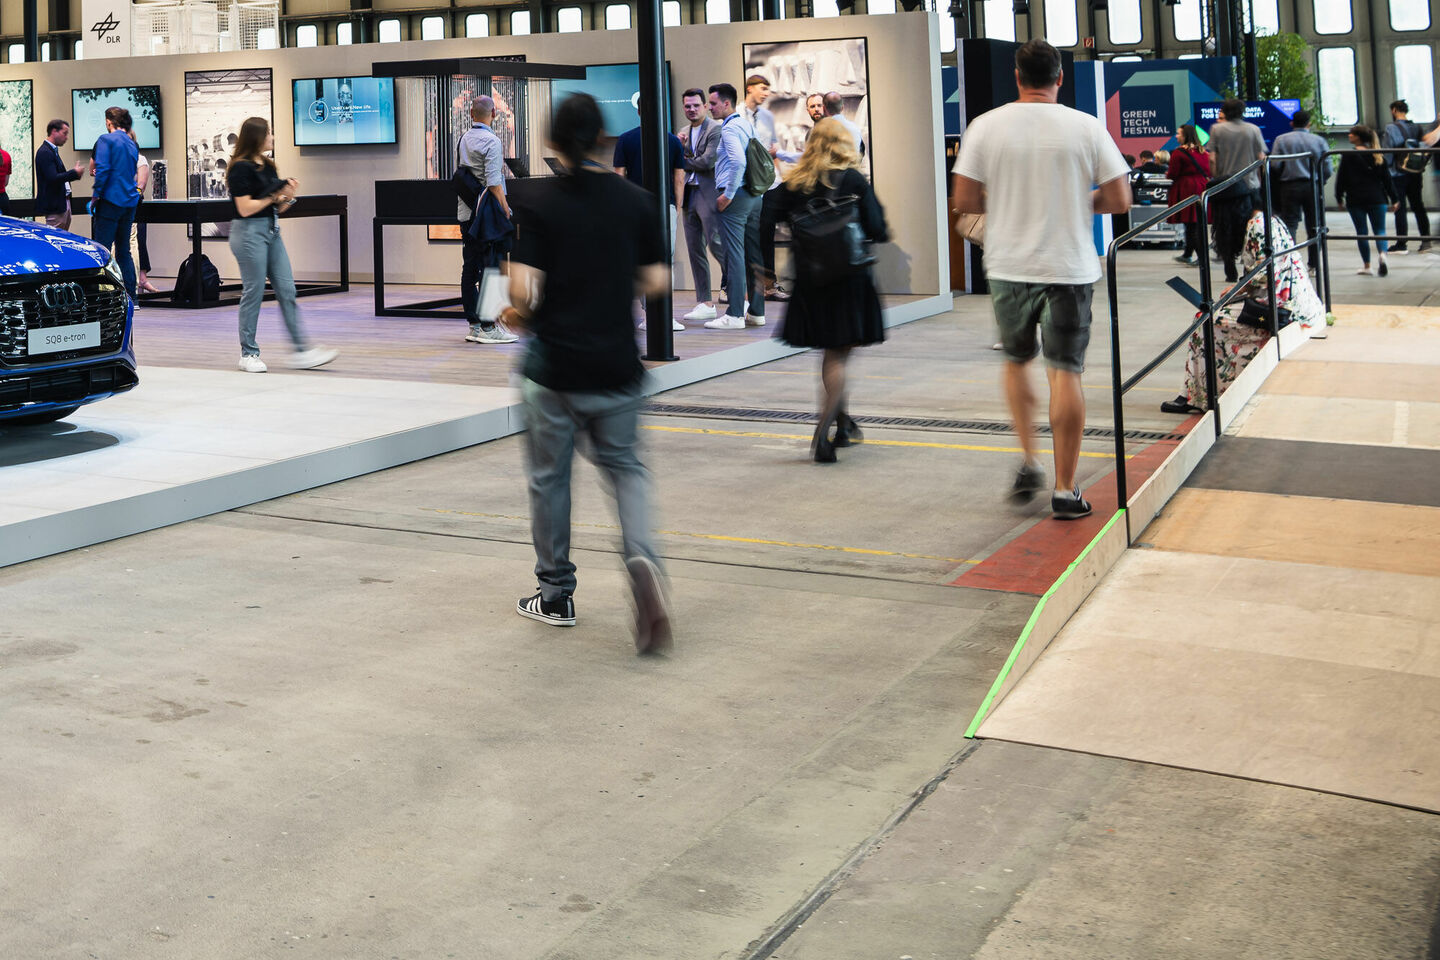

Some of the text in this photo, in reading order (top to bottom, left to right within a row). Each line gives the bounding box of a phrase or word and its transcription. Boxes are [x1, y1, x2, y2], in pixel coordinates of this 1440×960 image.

[106, 36, 121, 44] DLR
[1122, 110, 1157, 118] GREEN
[1123, 119, 1150, 127] TECH
[1124, 126, 1170, 135] FESTIVAL
[45, 333, 86, 344] SQ8 e-tron
